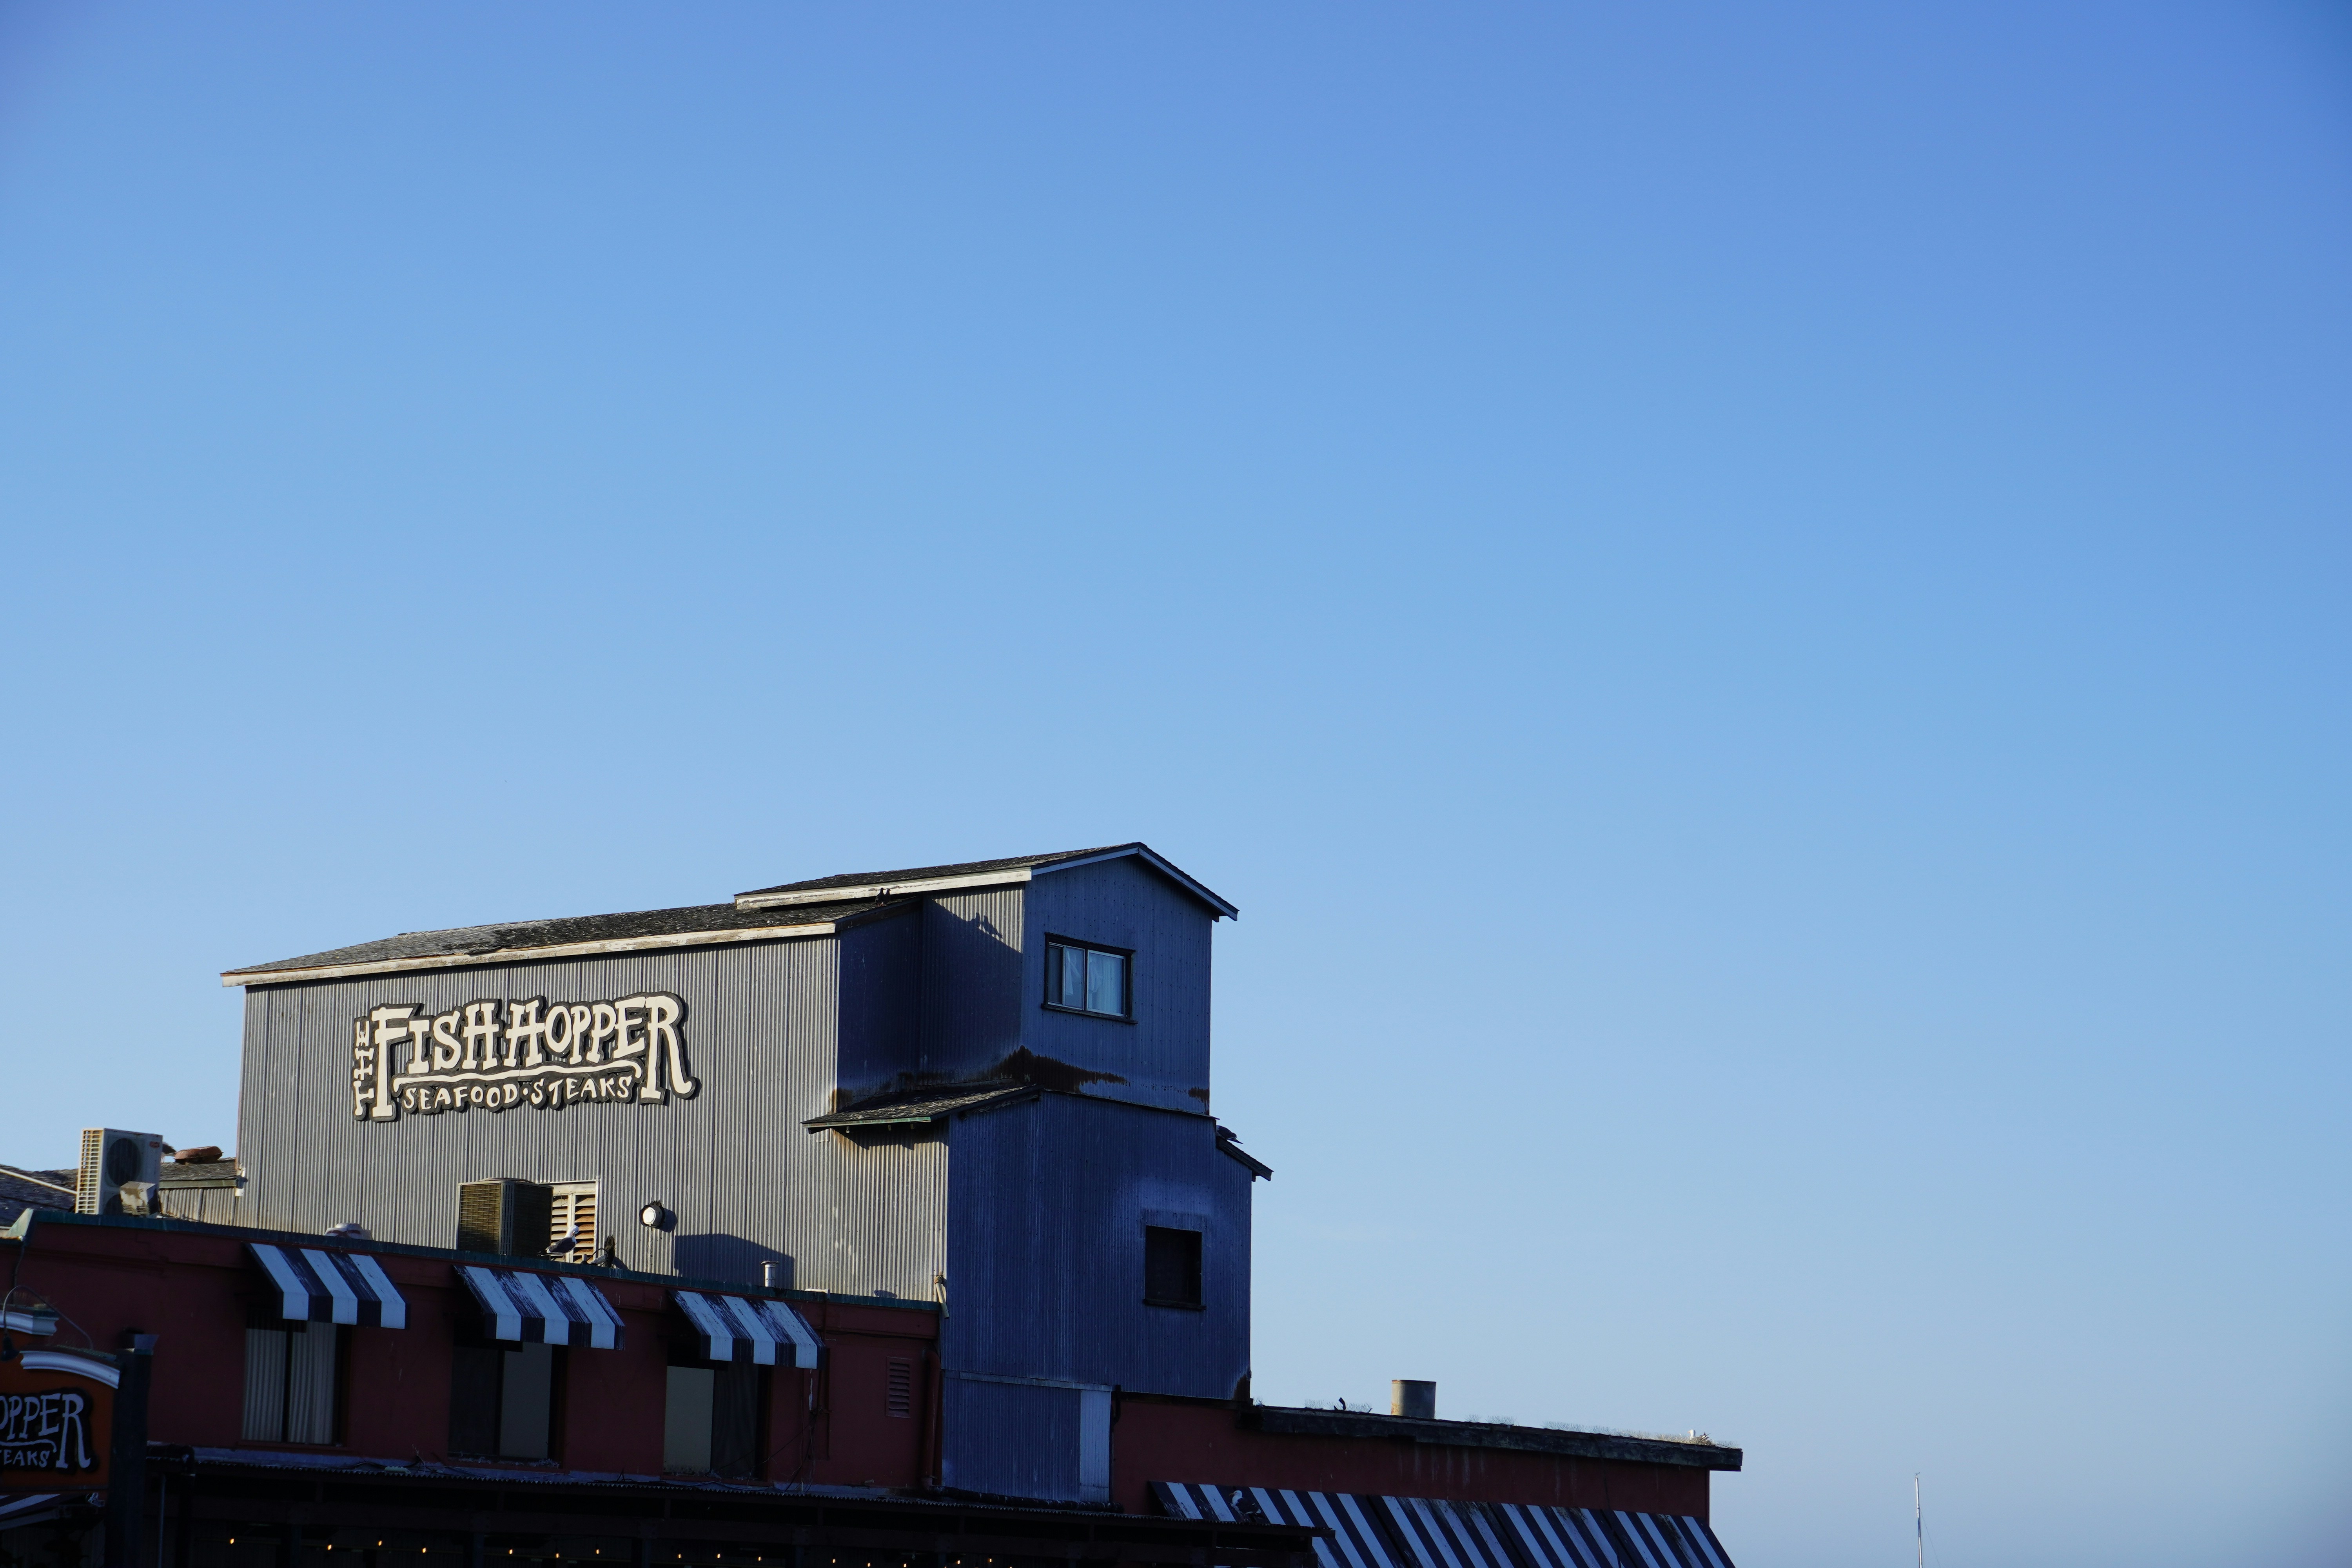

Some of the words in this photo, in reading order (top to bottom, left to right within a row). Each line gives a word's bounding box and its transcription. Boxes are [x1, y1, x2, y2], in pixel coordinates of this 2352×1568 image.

[353, 1021, 374, 1116] THE
[404, 1084, 518, 1110] SEAFOOD
[531, 1075, 632, 1105] STEAKS
[0, 1450, 50, 1468] EAKS
